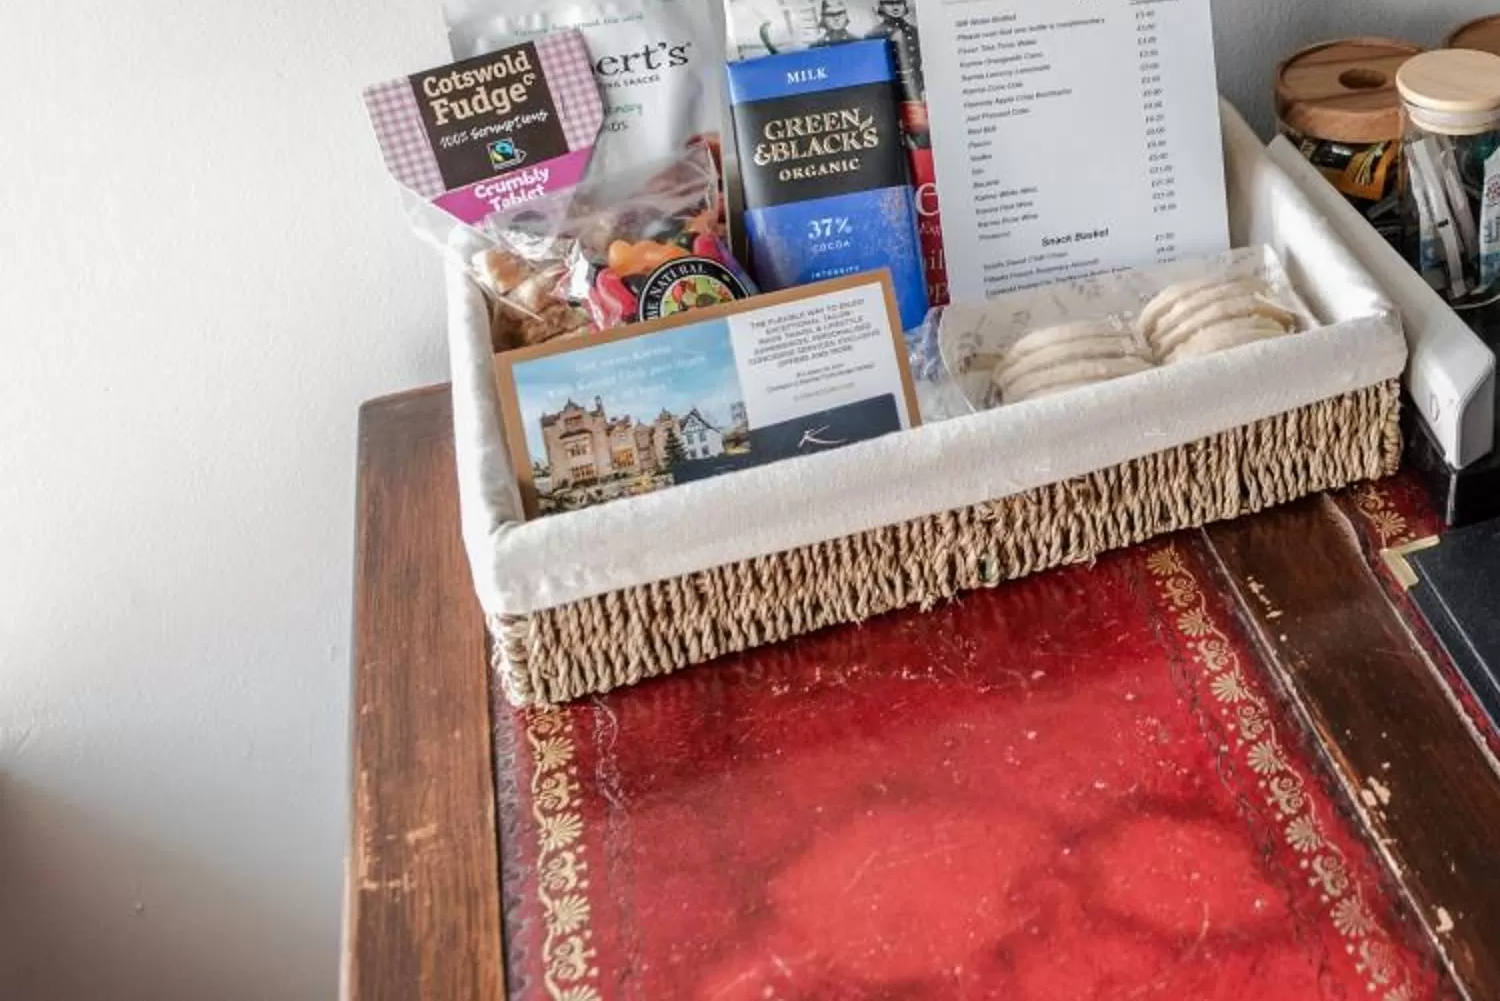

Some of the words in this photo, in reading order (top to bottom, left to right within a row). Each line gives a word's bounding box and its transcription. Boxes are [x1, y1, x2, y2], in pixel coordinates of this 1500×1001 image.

[423, 51, 533, 98] Cotswold
[592, 43, 689, 76] ert's
[786, 66, 829, 85] MILK
[429, 82, 529, 127] Fudge
[764, 107, 861, 141] GREEN
[474, 167, 550, 199] Crumbly
[778, 158, 861, 182] ORGANIC
[489, 184, 546, 213] Tablet
[807, 216, 852, 240] 37%
[1041, 235, 1072, 248] Snack
[1074, 227, 1110, 242] Basket
[811, 240, 851, 253] COCOA
[652, 262, 706, 296] NATURAL
